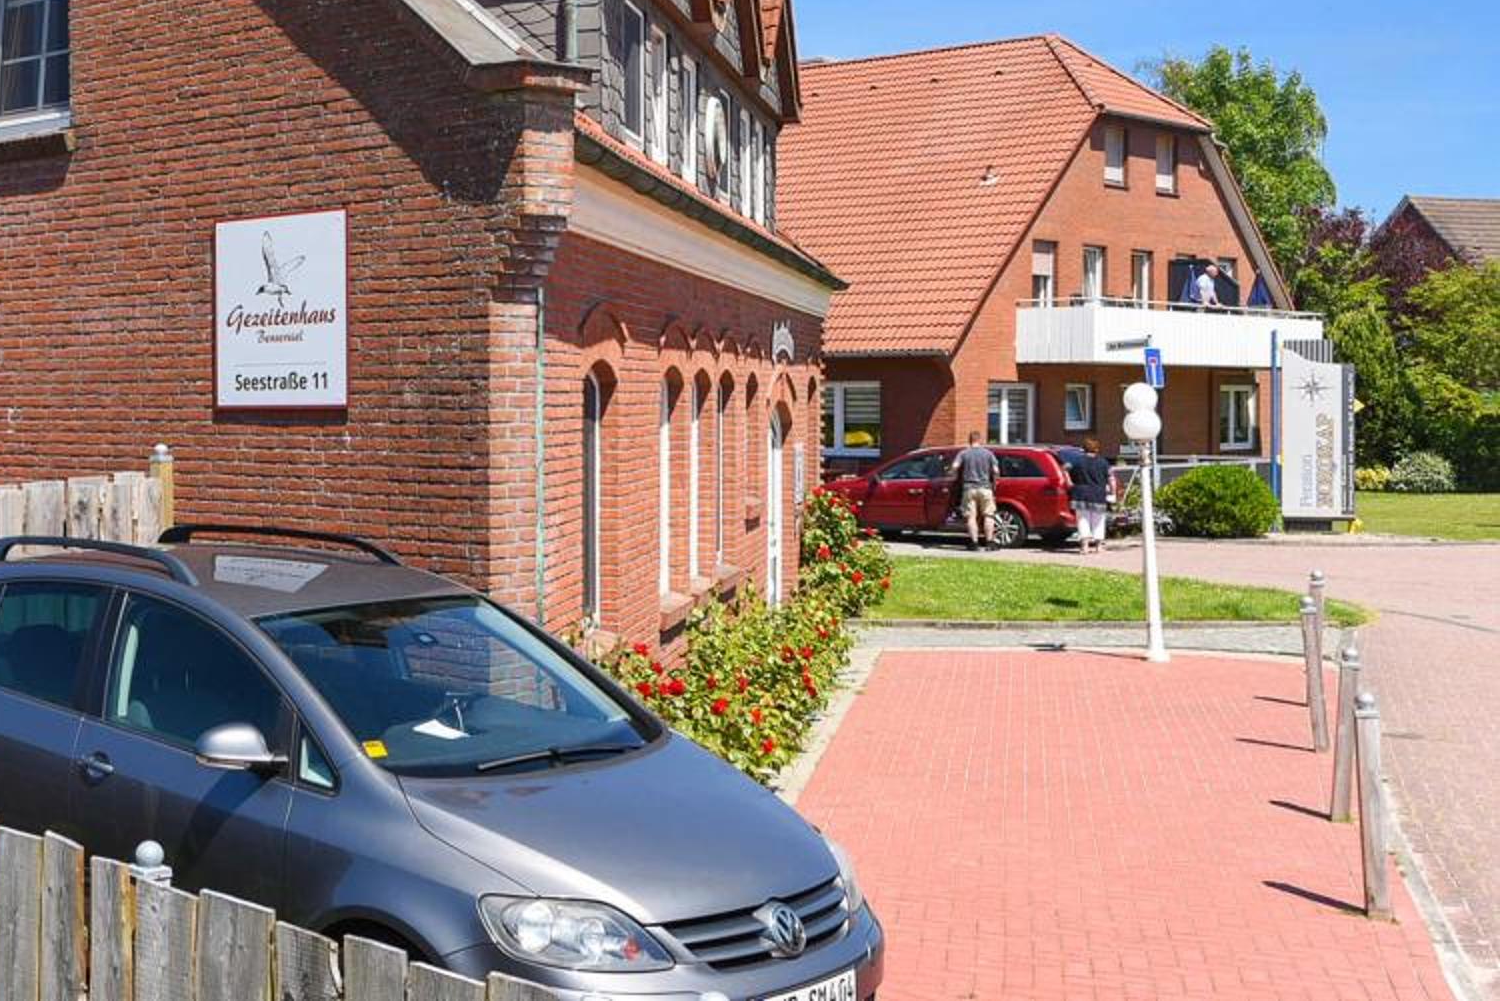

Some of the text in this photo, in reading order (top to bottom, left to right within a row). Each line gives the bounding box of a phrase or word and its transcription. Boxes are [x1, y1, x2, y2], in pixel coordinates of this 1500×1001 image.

[226, 300, 336, 335] Gezeitenhaus
[235, 372, 328, 391] Seestraße 11
